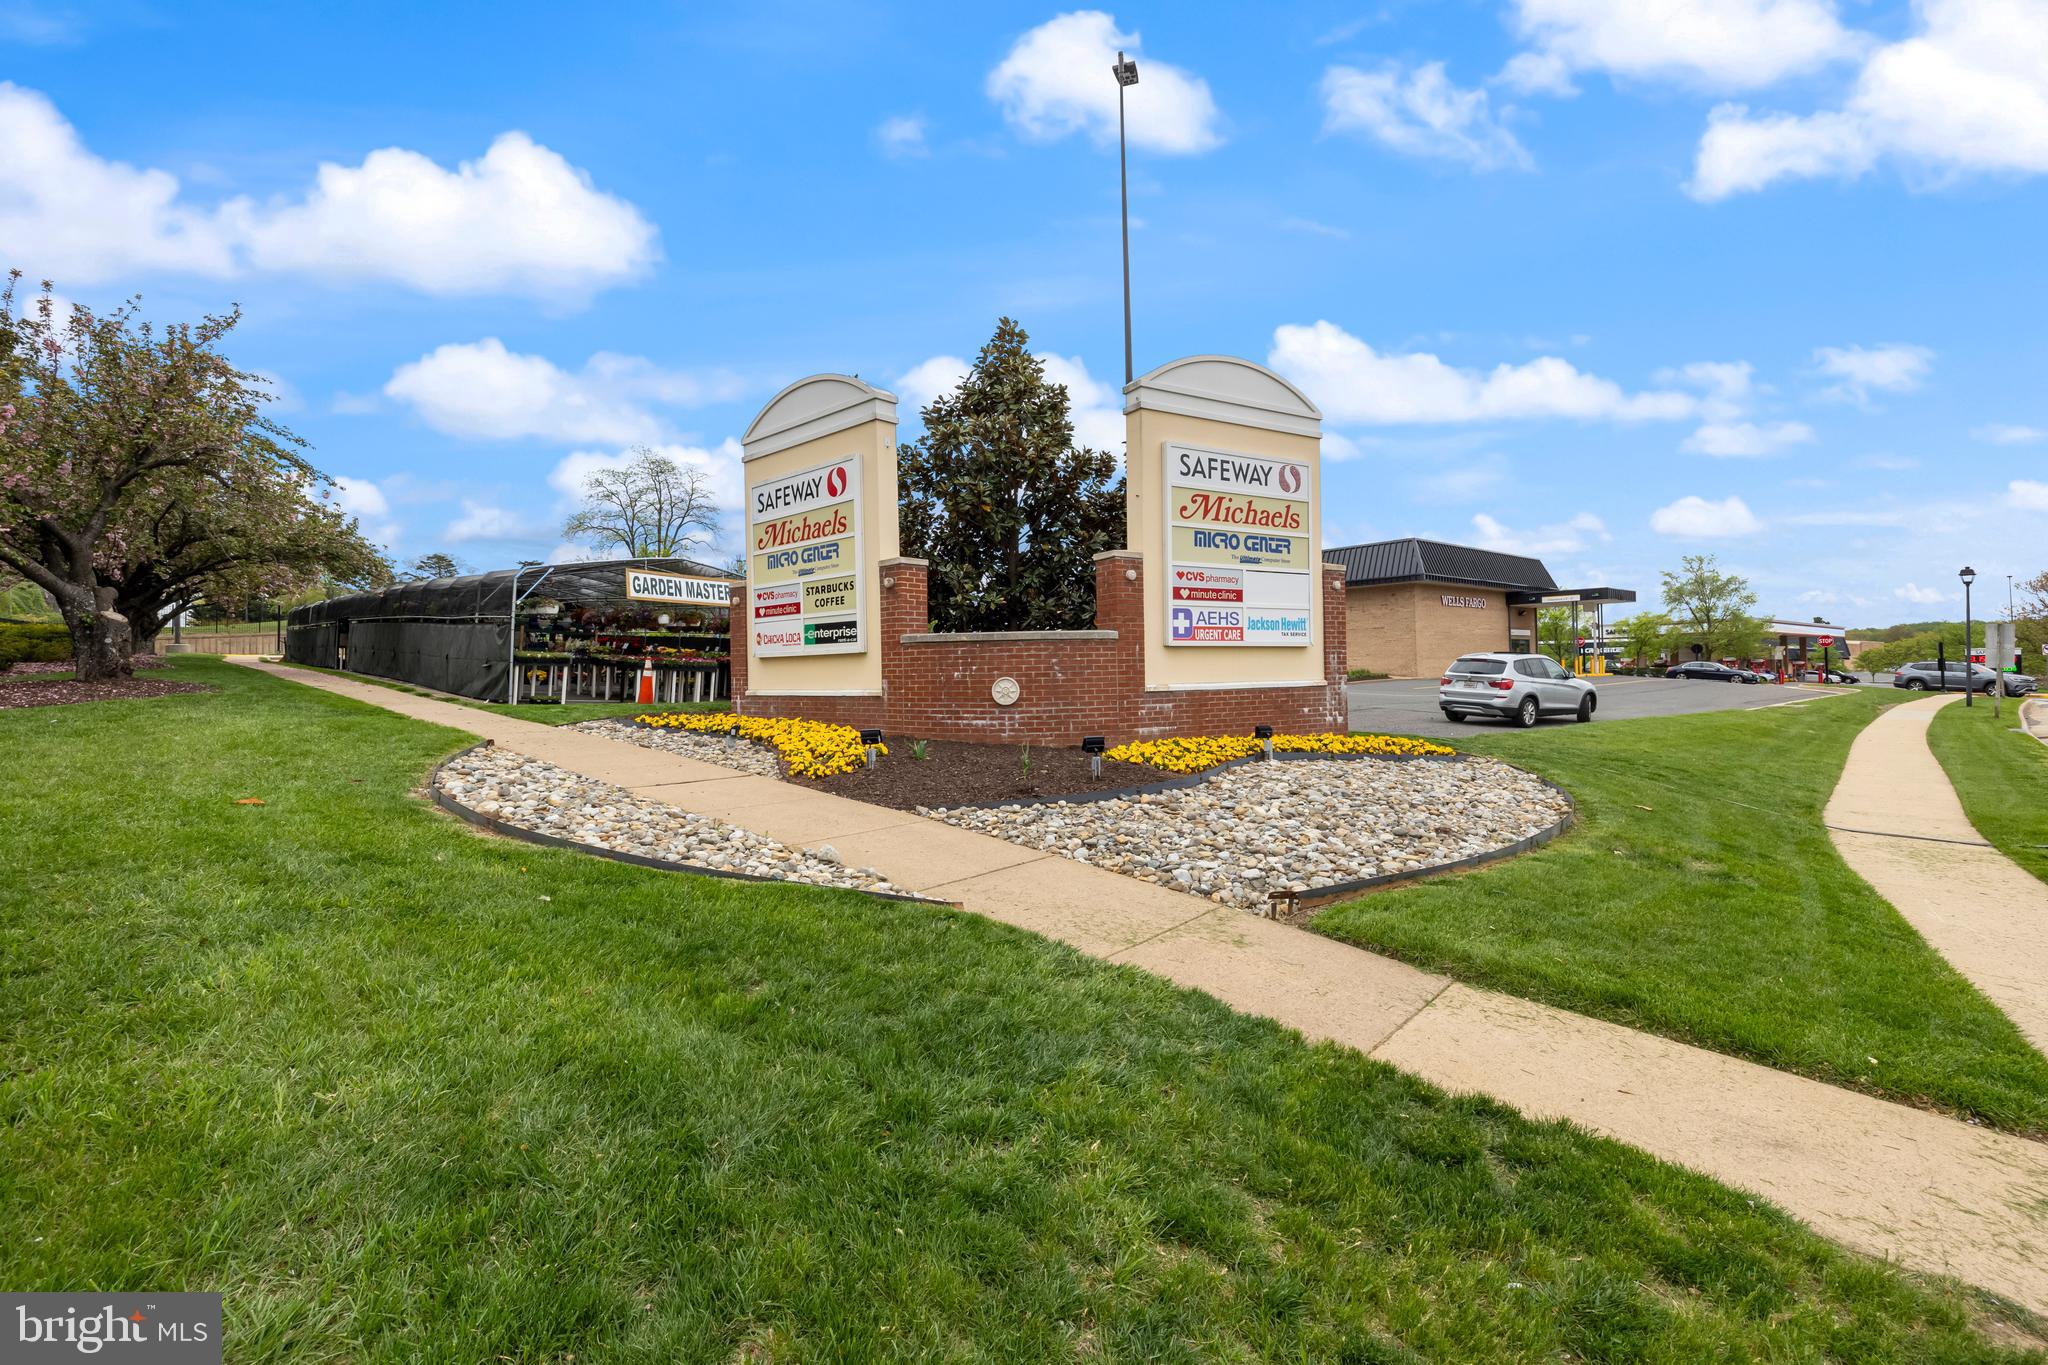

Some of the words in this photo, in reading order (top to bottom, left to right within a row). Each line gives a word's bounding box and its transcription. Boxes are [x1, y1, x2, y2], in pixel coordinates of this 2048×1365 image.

[1179, 453, 1273, 487] SAFEWAY
[757, 476, 823, 513] SAFEWAY
[1179, 493, 1300, 530] Michaels
[758, 509, 847, 550] Michaels
[1194, 530, 1240, 550] MICRO
[1244, 535, 1291, 555] CENTER
[767, 550, 799, 570] MICRO
[801, 543, 839, 564] CENTER
[1186, 571, 1205, 582] CVS
[1206, 573, 1240, 585] pharmacy
[632, 575, 682, 597] GARDEN
[806, 581, 854, 596] STARBUCKS
[763, 591, 774, 601] CVS
[815, 596, 845, 608] COFFEE
[1191, 590, 1217, 599] minute
[1218, 590, 1237, 600] clinic
[1440, 595, 1464, 608] WELLS
[1466, 597, 1486, 609] FARGO
[1196, 611, 1240, 626] AEHS
[1247, 616, 1280, 631] Jackson
[1281, 617, 1307, 631] Hewitt
[786, 632, 801, 643] LOCA
[806, 626, 857, 640] enterprise
[1194, 628, 1222, 640] URGENT
[1223, 629, 1241, 641] CARE
